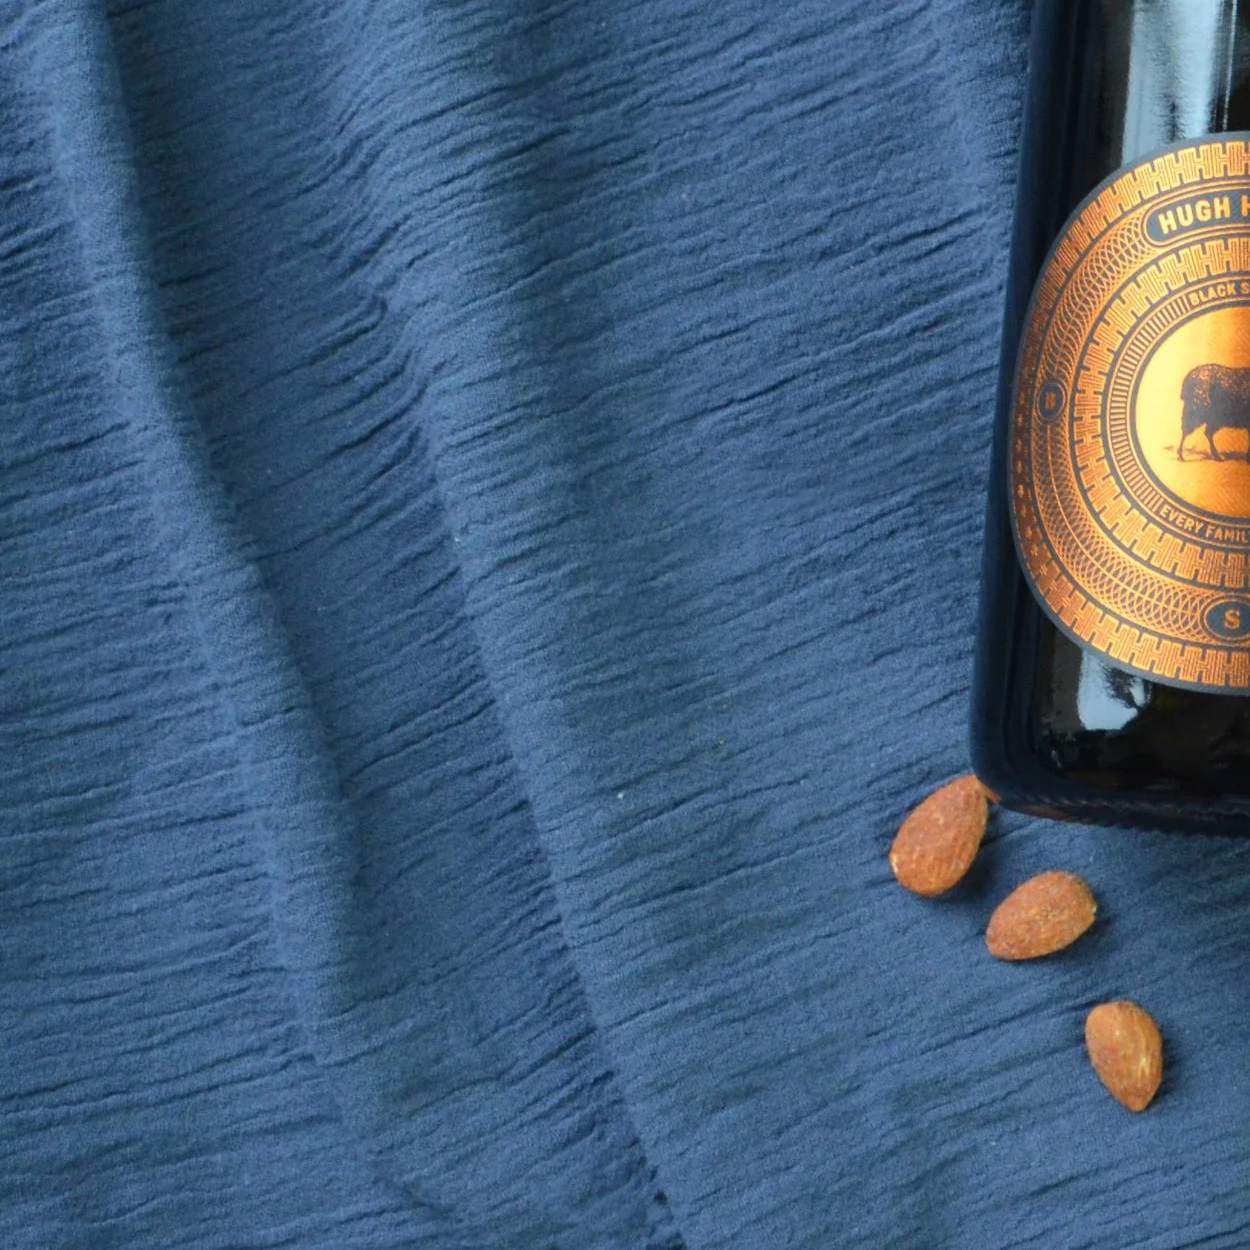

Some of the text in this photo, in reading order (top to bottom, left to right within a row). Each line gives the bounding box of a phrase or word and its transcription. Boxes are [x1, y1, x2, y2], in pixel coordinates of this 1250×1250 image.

[1158, 196, 1231, 235] HUGH
[1189, 280, 1237, 306] BLACK
[1159, 505, 1206, 534] EVERY
[1223, 608, 1241, 630] S
